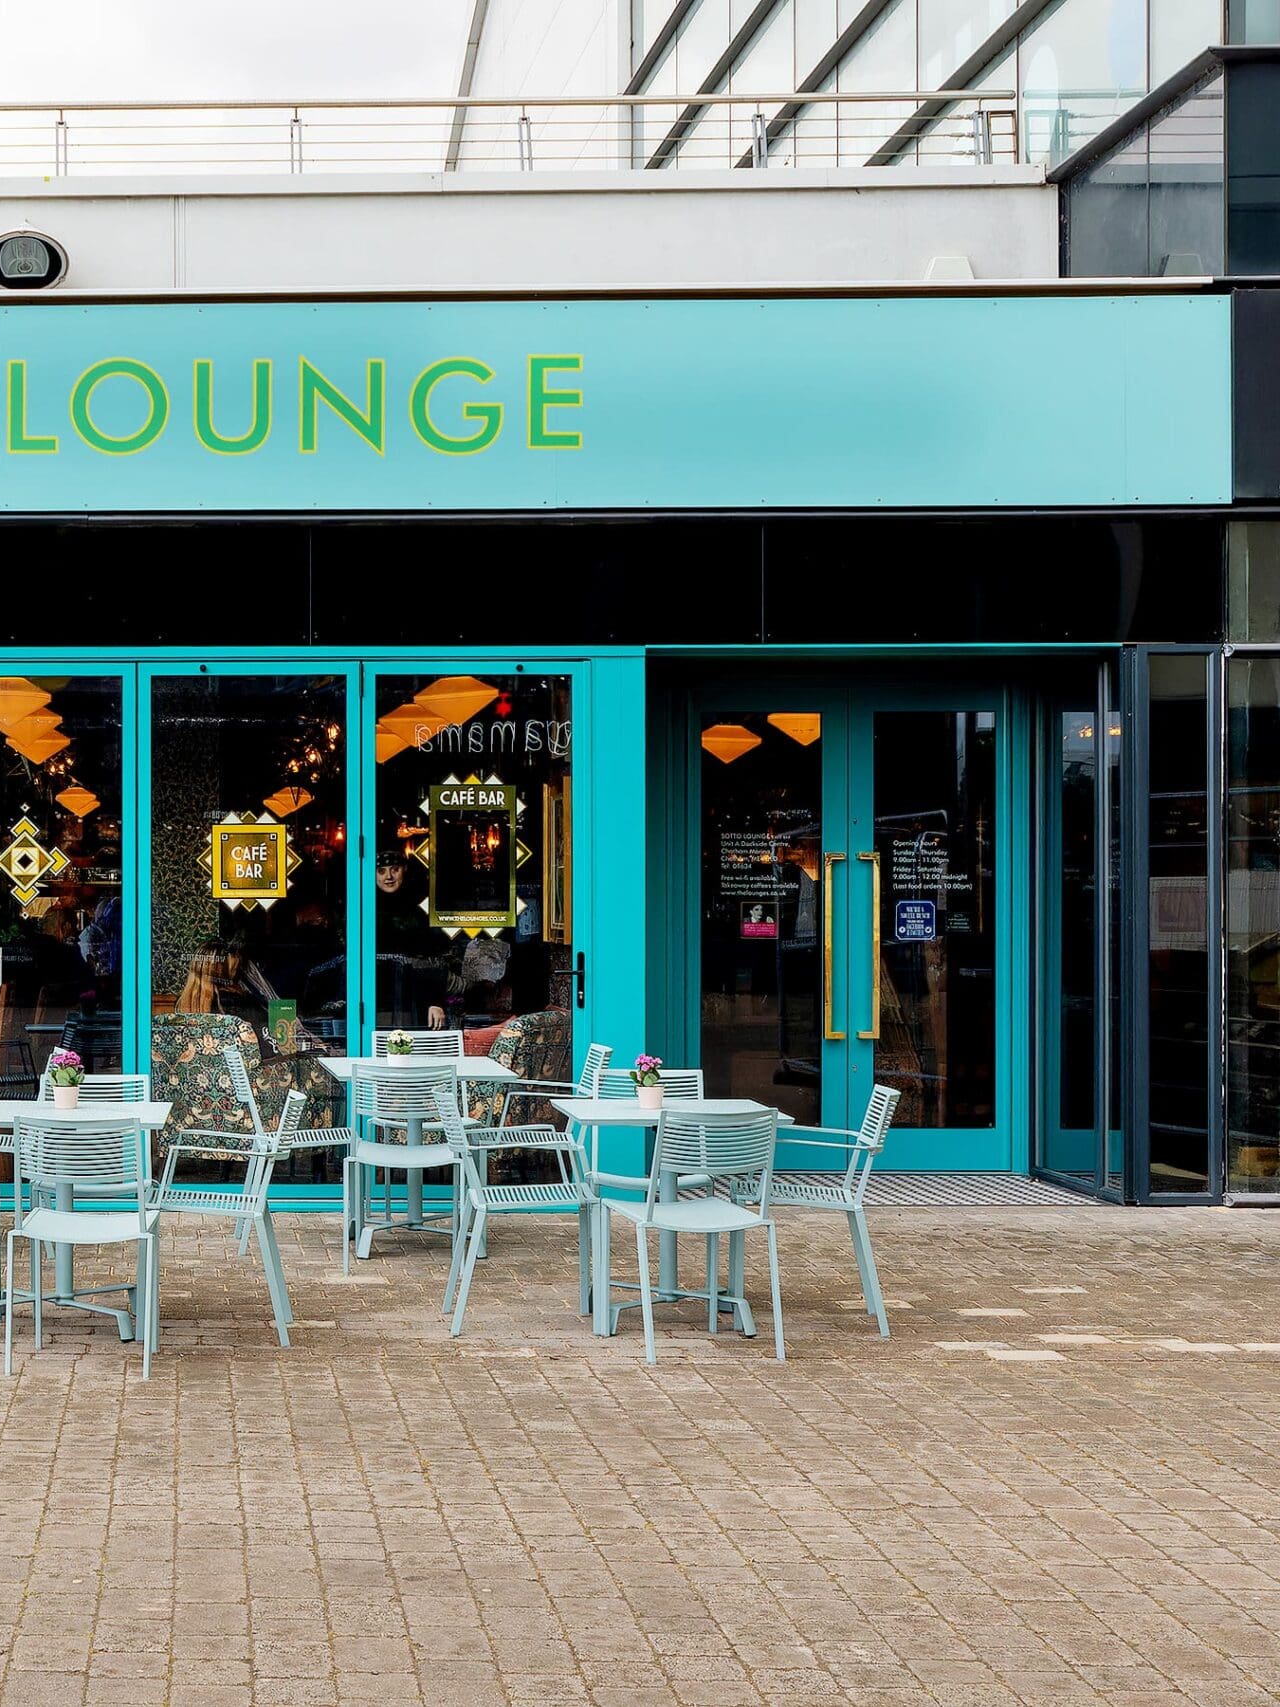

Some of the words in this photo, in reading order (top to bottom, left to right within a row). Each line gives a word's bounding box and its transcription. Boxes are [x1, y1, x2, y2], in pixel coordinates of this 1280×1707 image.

[6, 353, 585, 459] LOUNGE
[440, 787, 475, 806] CAFÉ
[478, 790, 505, 806] BAR
[231, 842, 267, 861] CAFÉ
[235, 863, 263, 879] BAR
